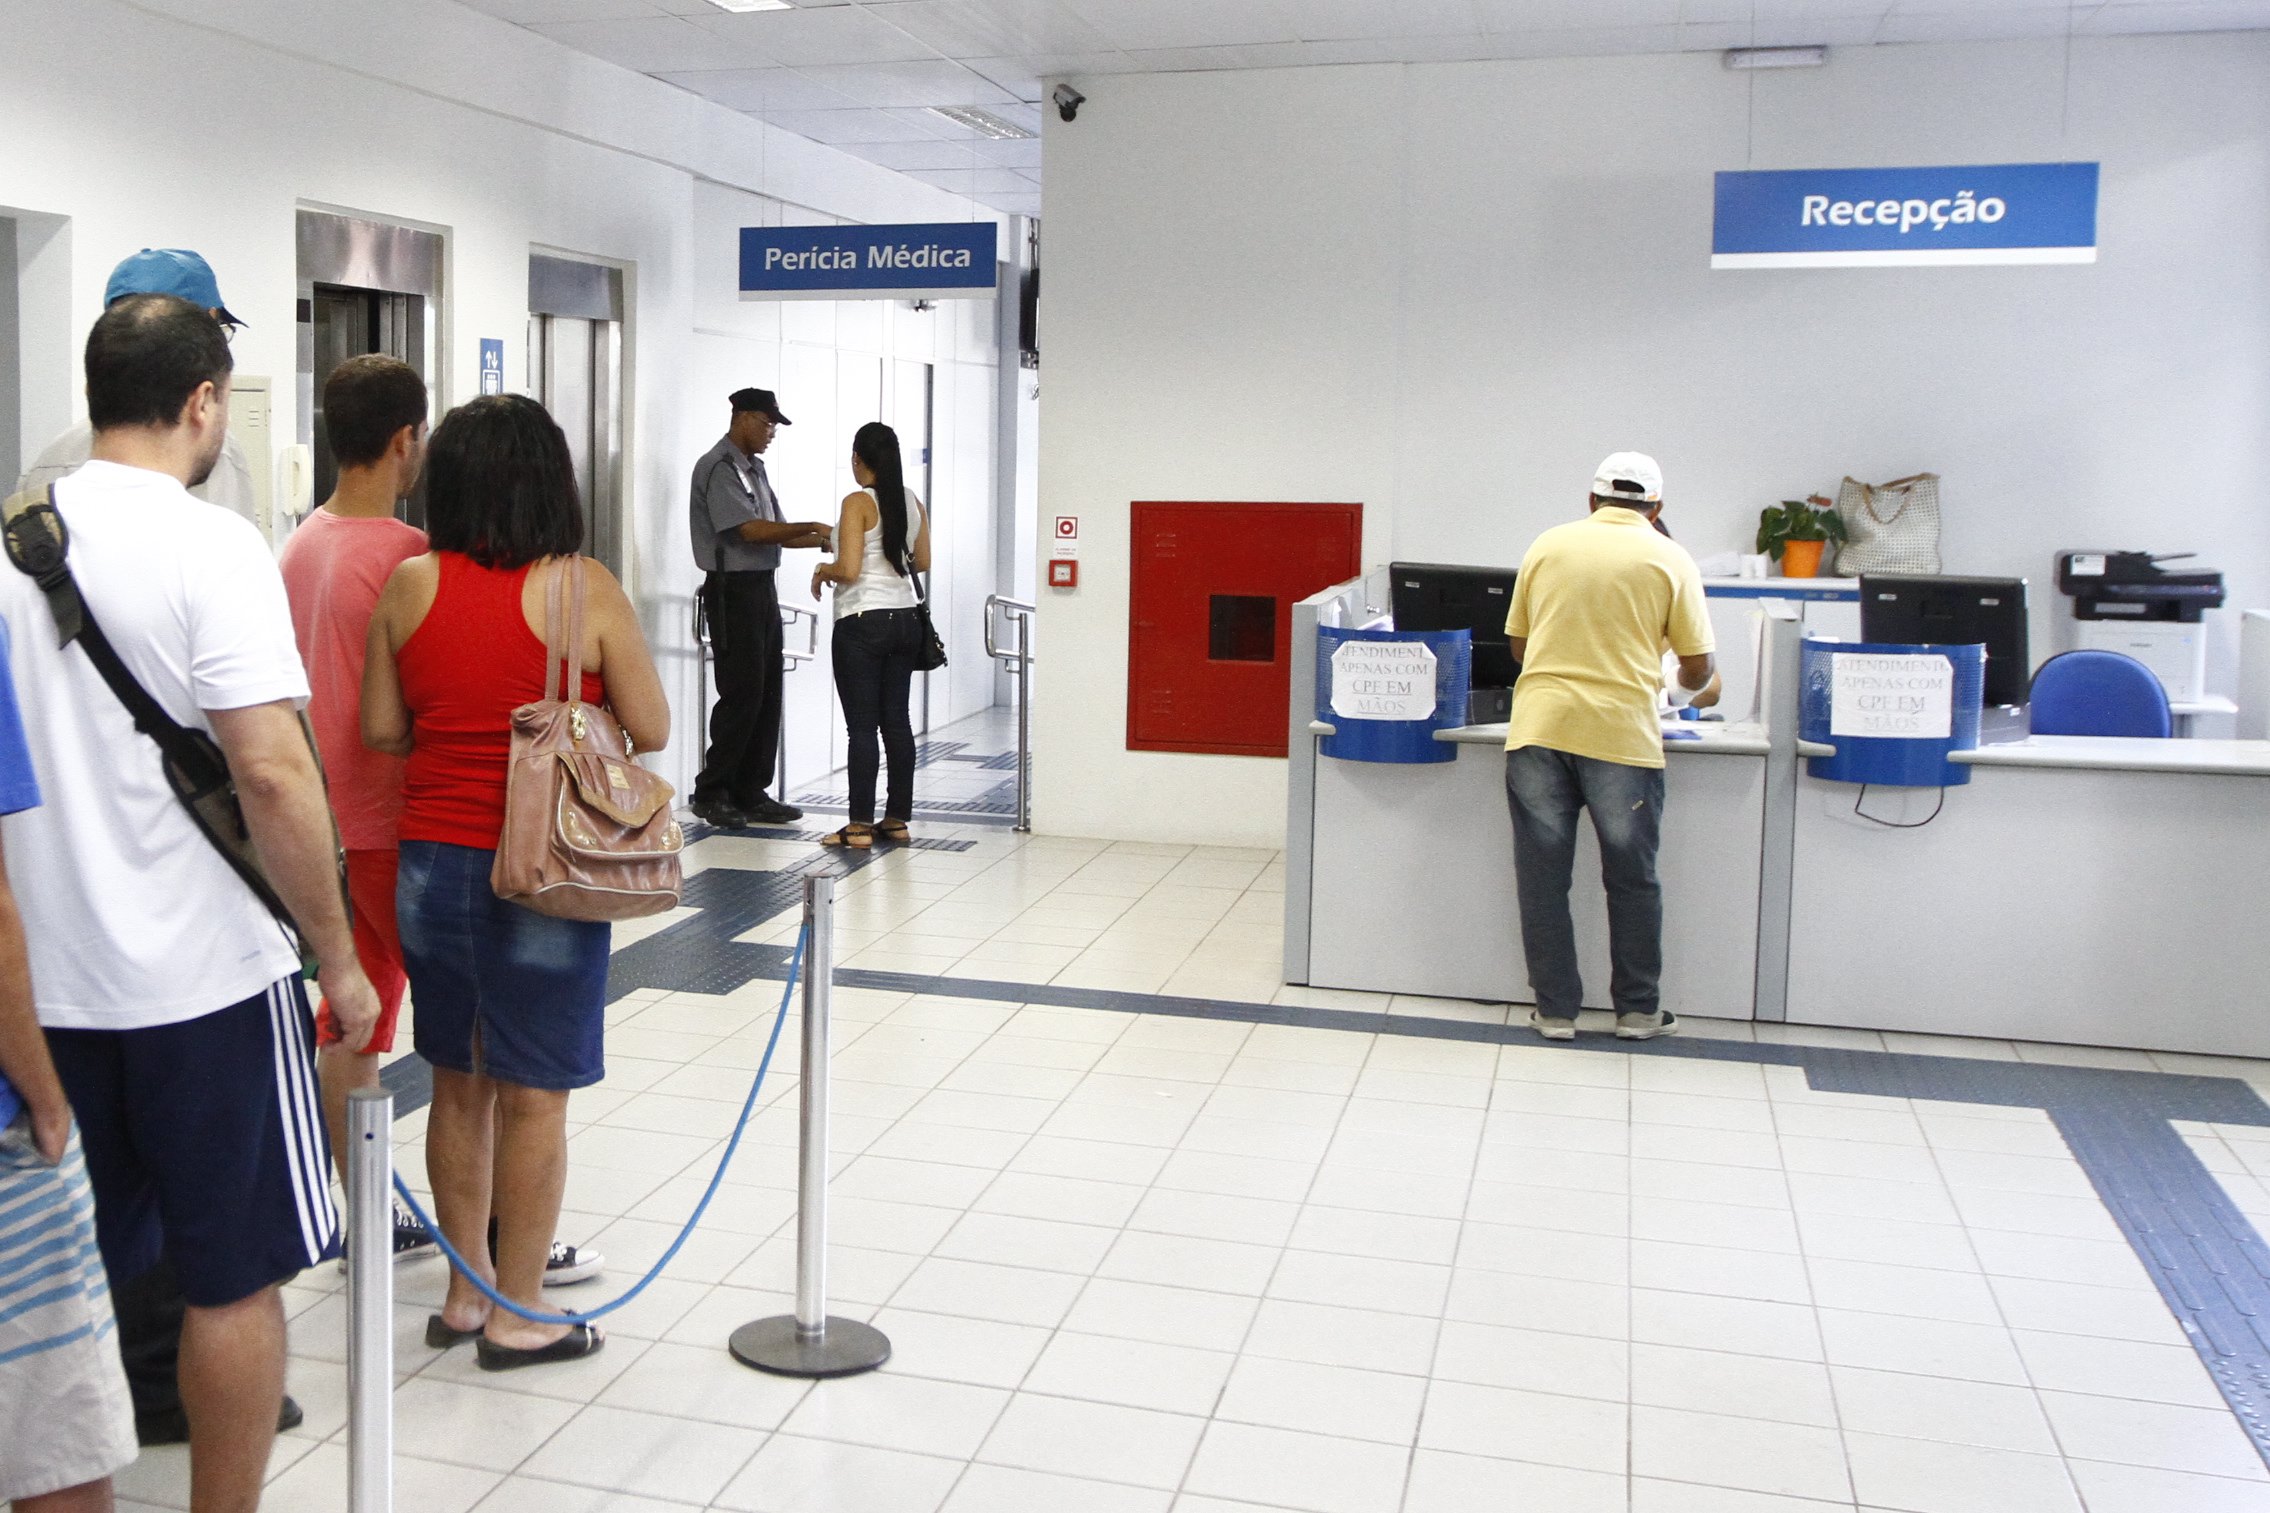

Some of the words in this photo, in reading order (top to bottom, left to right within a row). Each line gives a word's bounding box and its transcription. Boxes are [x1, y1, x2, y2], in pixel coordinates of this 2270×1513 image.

[1801, 190, 2006, 233] Recepção
[765, 246, 857, 270] Perícia
[867, 244, 971, 269] Médica
[1340, 662, 1392, 675] APENAS
[1395, 663, 1428, 675] COM
[1352, 680, 1381, 693] CPF
[1387, 681, 1412, 694] EM
[1841, 676, 1905, 689] APENAS
[1908, 677, 1943, 690] COM
[1358, 696, 1406, 713] MÃOS
[1898, 695, 1926, 710] EM
